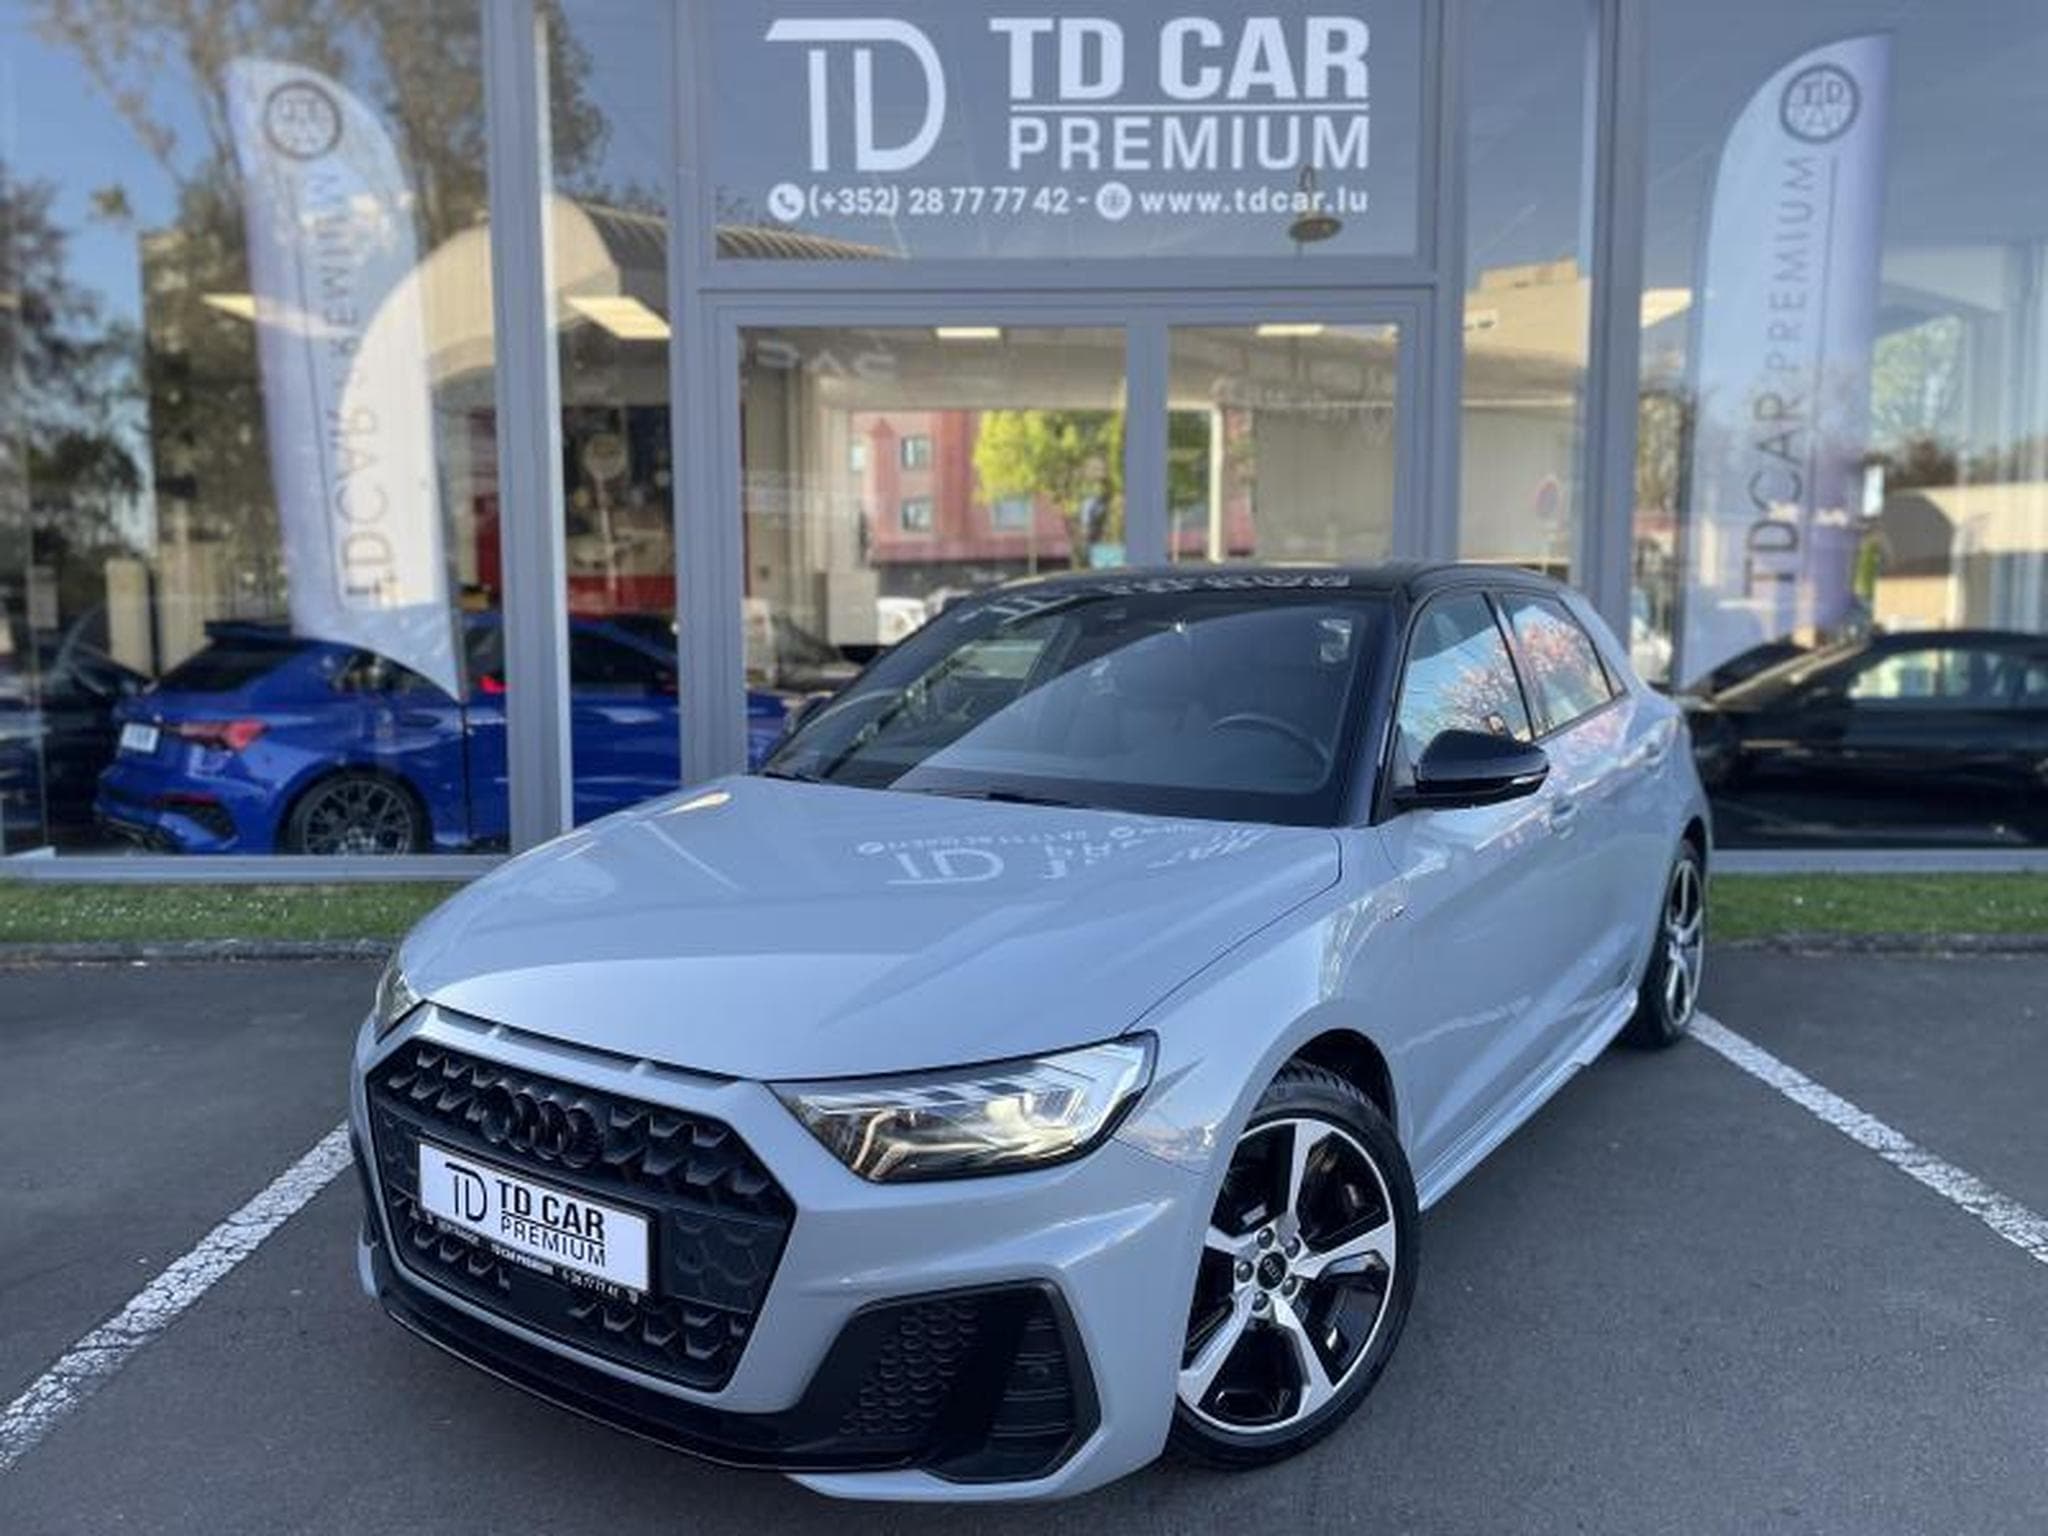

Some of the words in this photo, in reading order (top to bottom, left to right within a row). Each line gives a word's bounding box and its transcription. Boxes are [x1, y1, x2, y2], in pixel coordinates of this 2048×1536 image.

[990, 17, 1124, 100] TD
[1159, 16, 1370, 100] CAR
[1009, 116, 1370, 170] PREMIUM
[808, 184, 900, 218] (+352)
[1140, 186, 1369, 213] www.tdcar.lu
[496, 1179, 532, 1217] TD
[542, 1194, 606, 1241] CAR
[500, 1216, 606, 1268] PREMIUM
